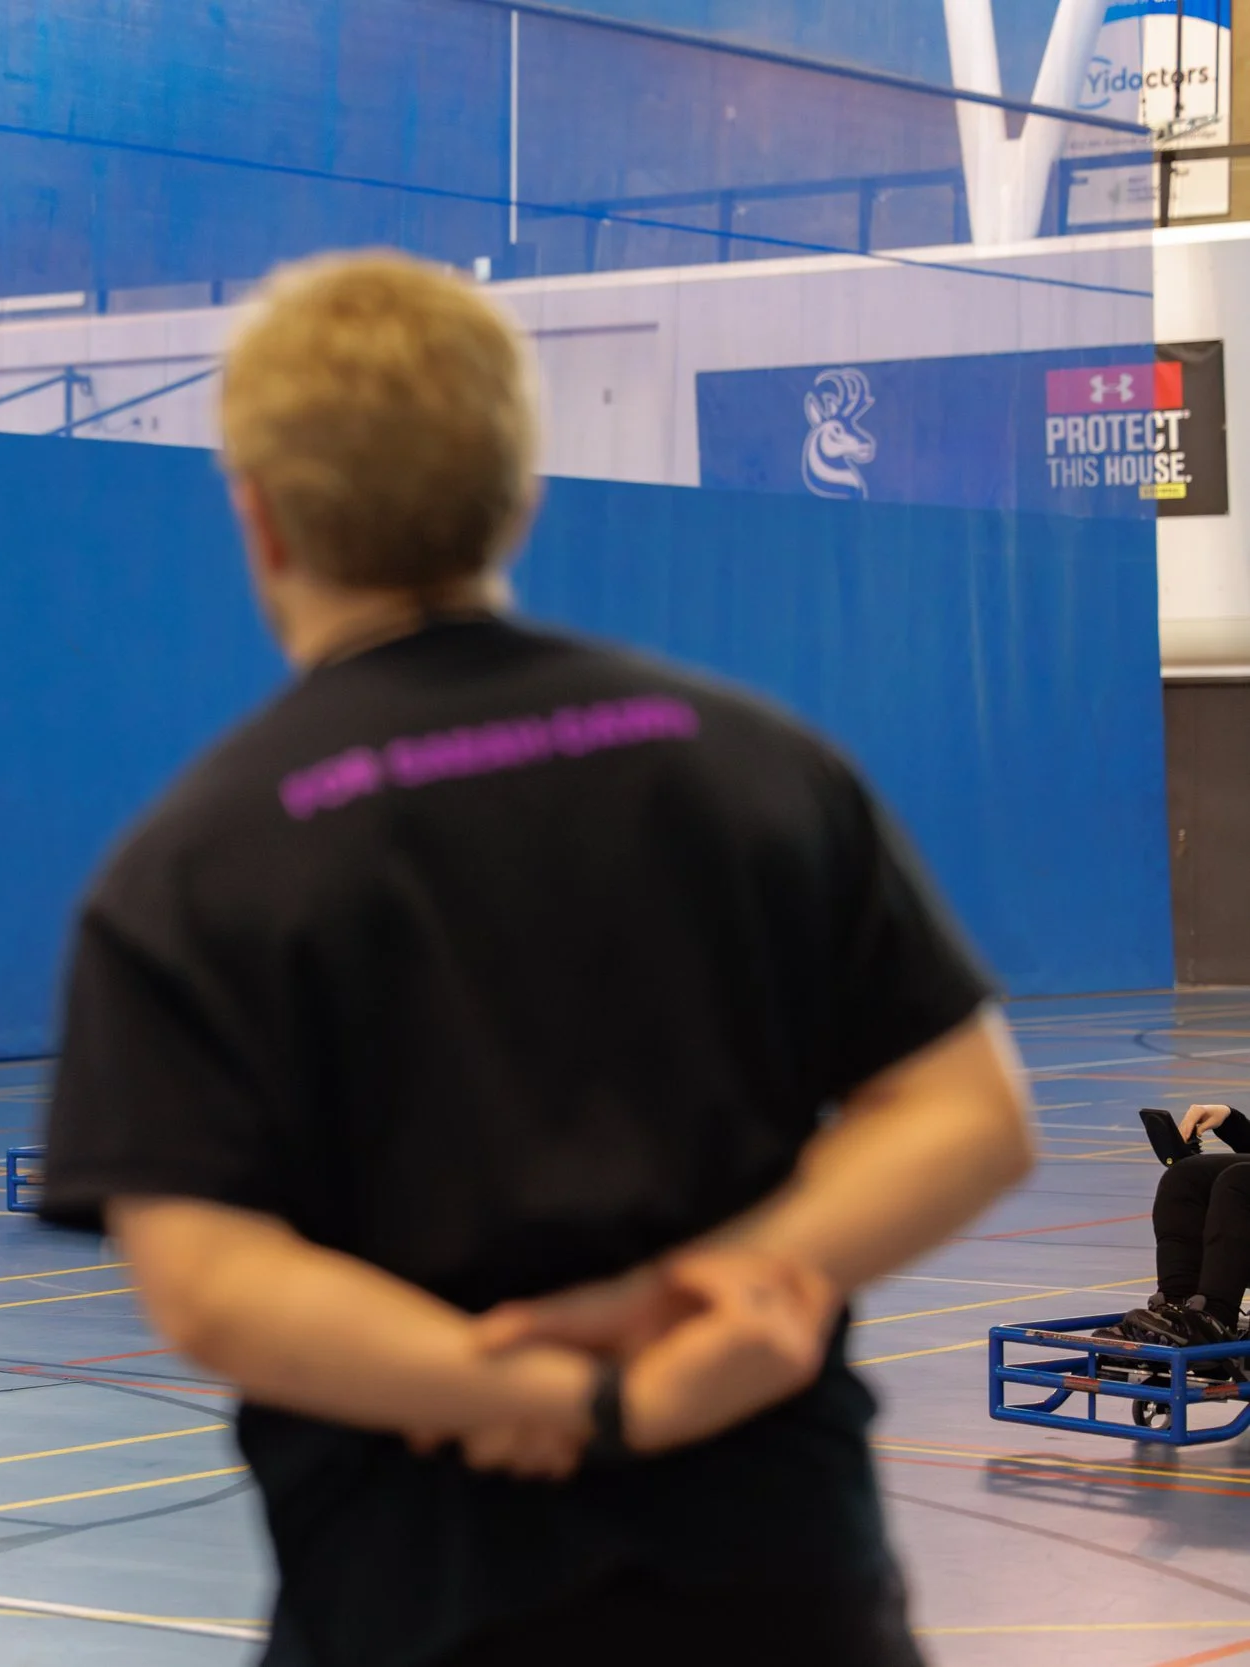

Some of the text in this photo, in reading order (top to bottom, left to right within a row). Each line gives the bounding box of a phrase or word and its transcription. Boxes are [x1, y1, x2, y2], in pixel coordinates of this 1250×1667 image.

[1046, 410, 1180, 455] PROTECT
[1047, 452, 1193, 488] THIS HOUSE.
